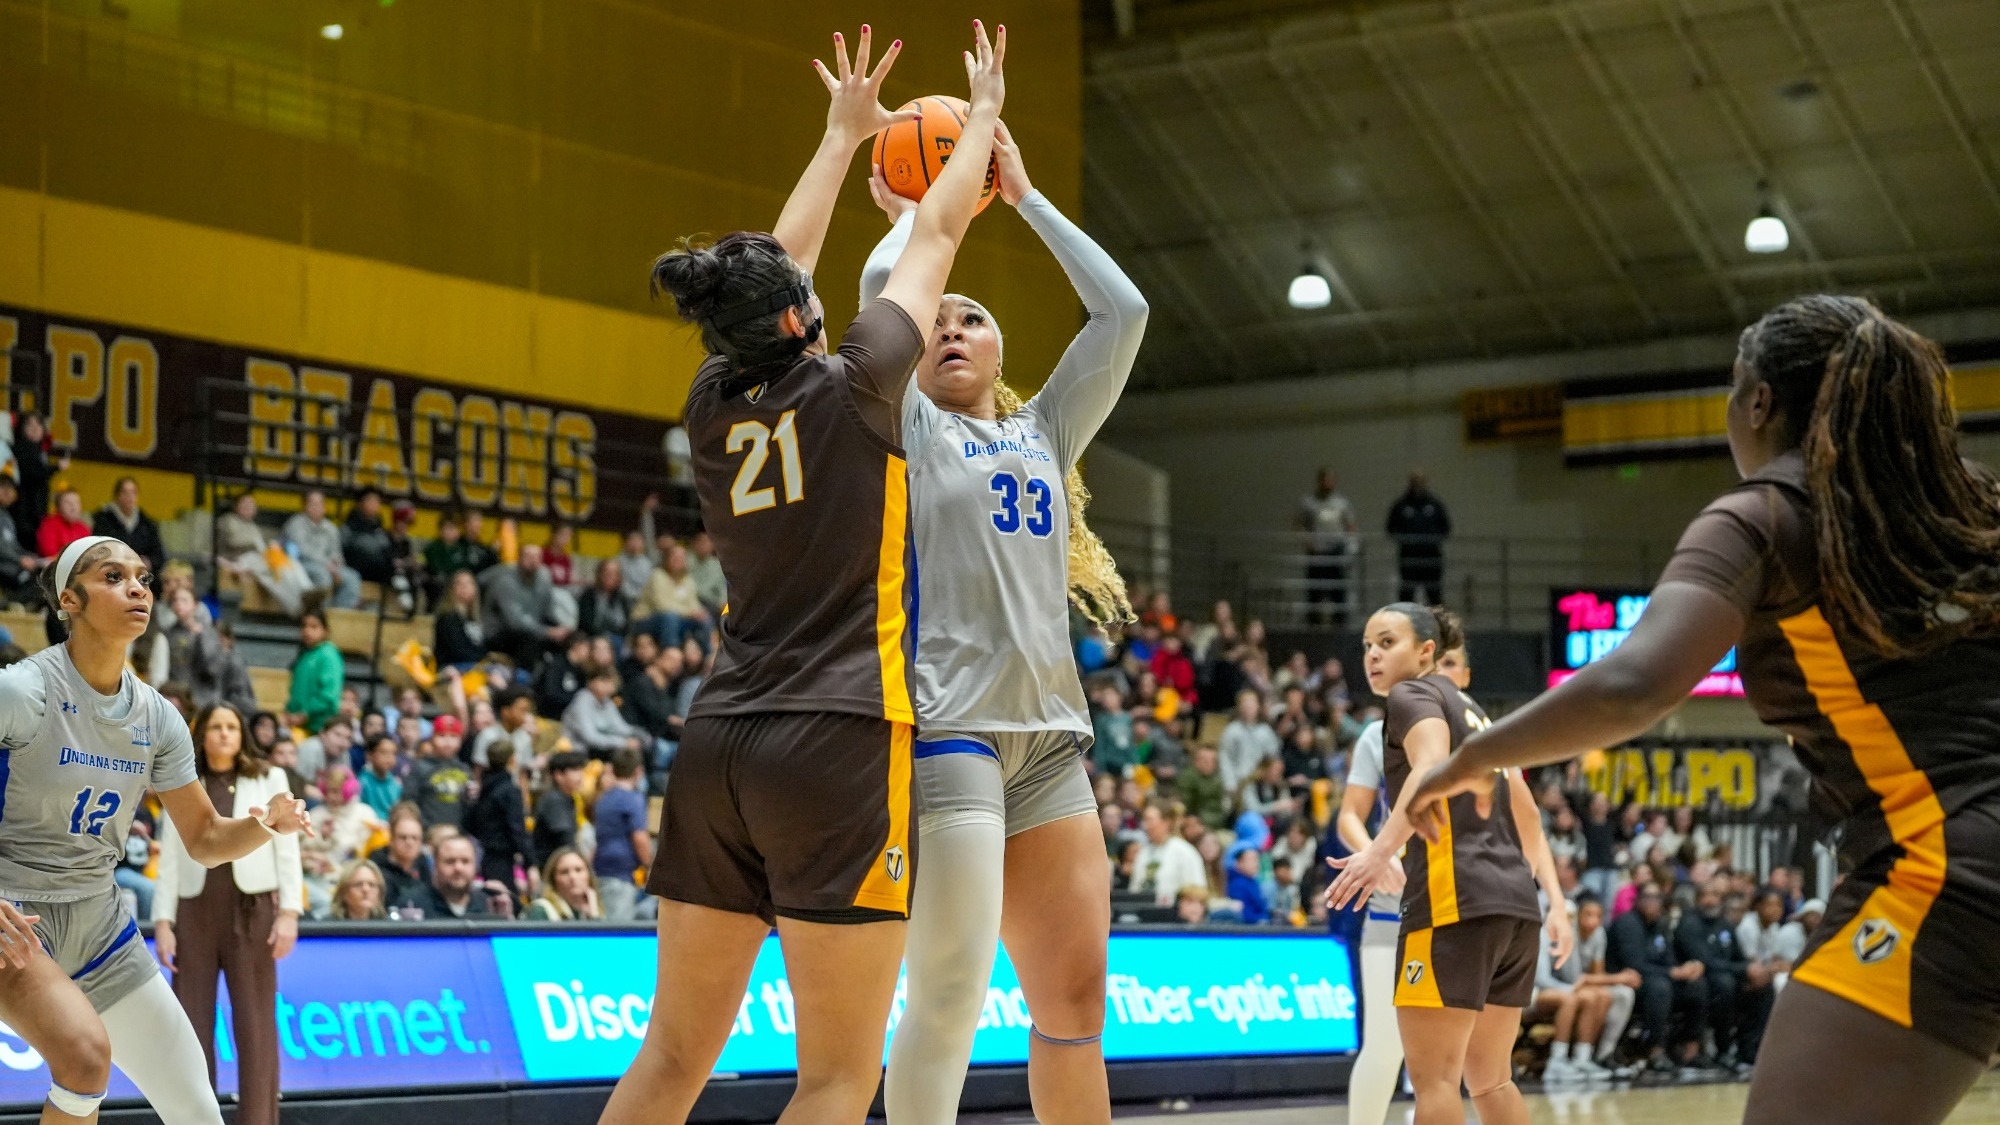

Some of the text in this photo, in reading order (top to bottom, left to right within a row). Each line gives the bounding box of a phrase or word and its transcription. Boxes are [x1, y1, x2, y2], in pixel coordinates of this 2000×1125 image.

[244, 357, 597, 519] BEACONS
[726, 409, 804, 516] 21
[989, 470, 1054, 540] 33
[59, 747, 146, 774] INDIANA STATE
[67, 785, 122, 836] 12
[214, 988, 491, 1062] ternet.
[761, 978, 796, 1034] th
